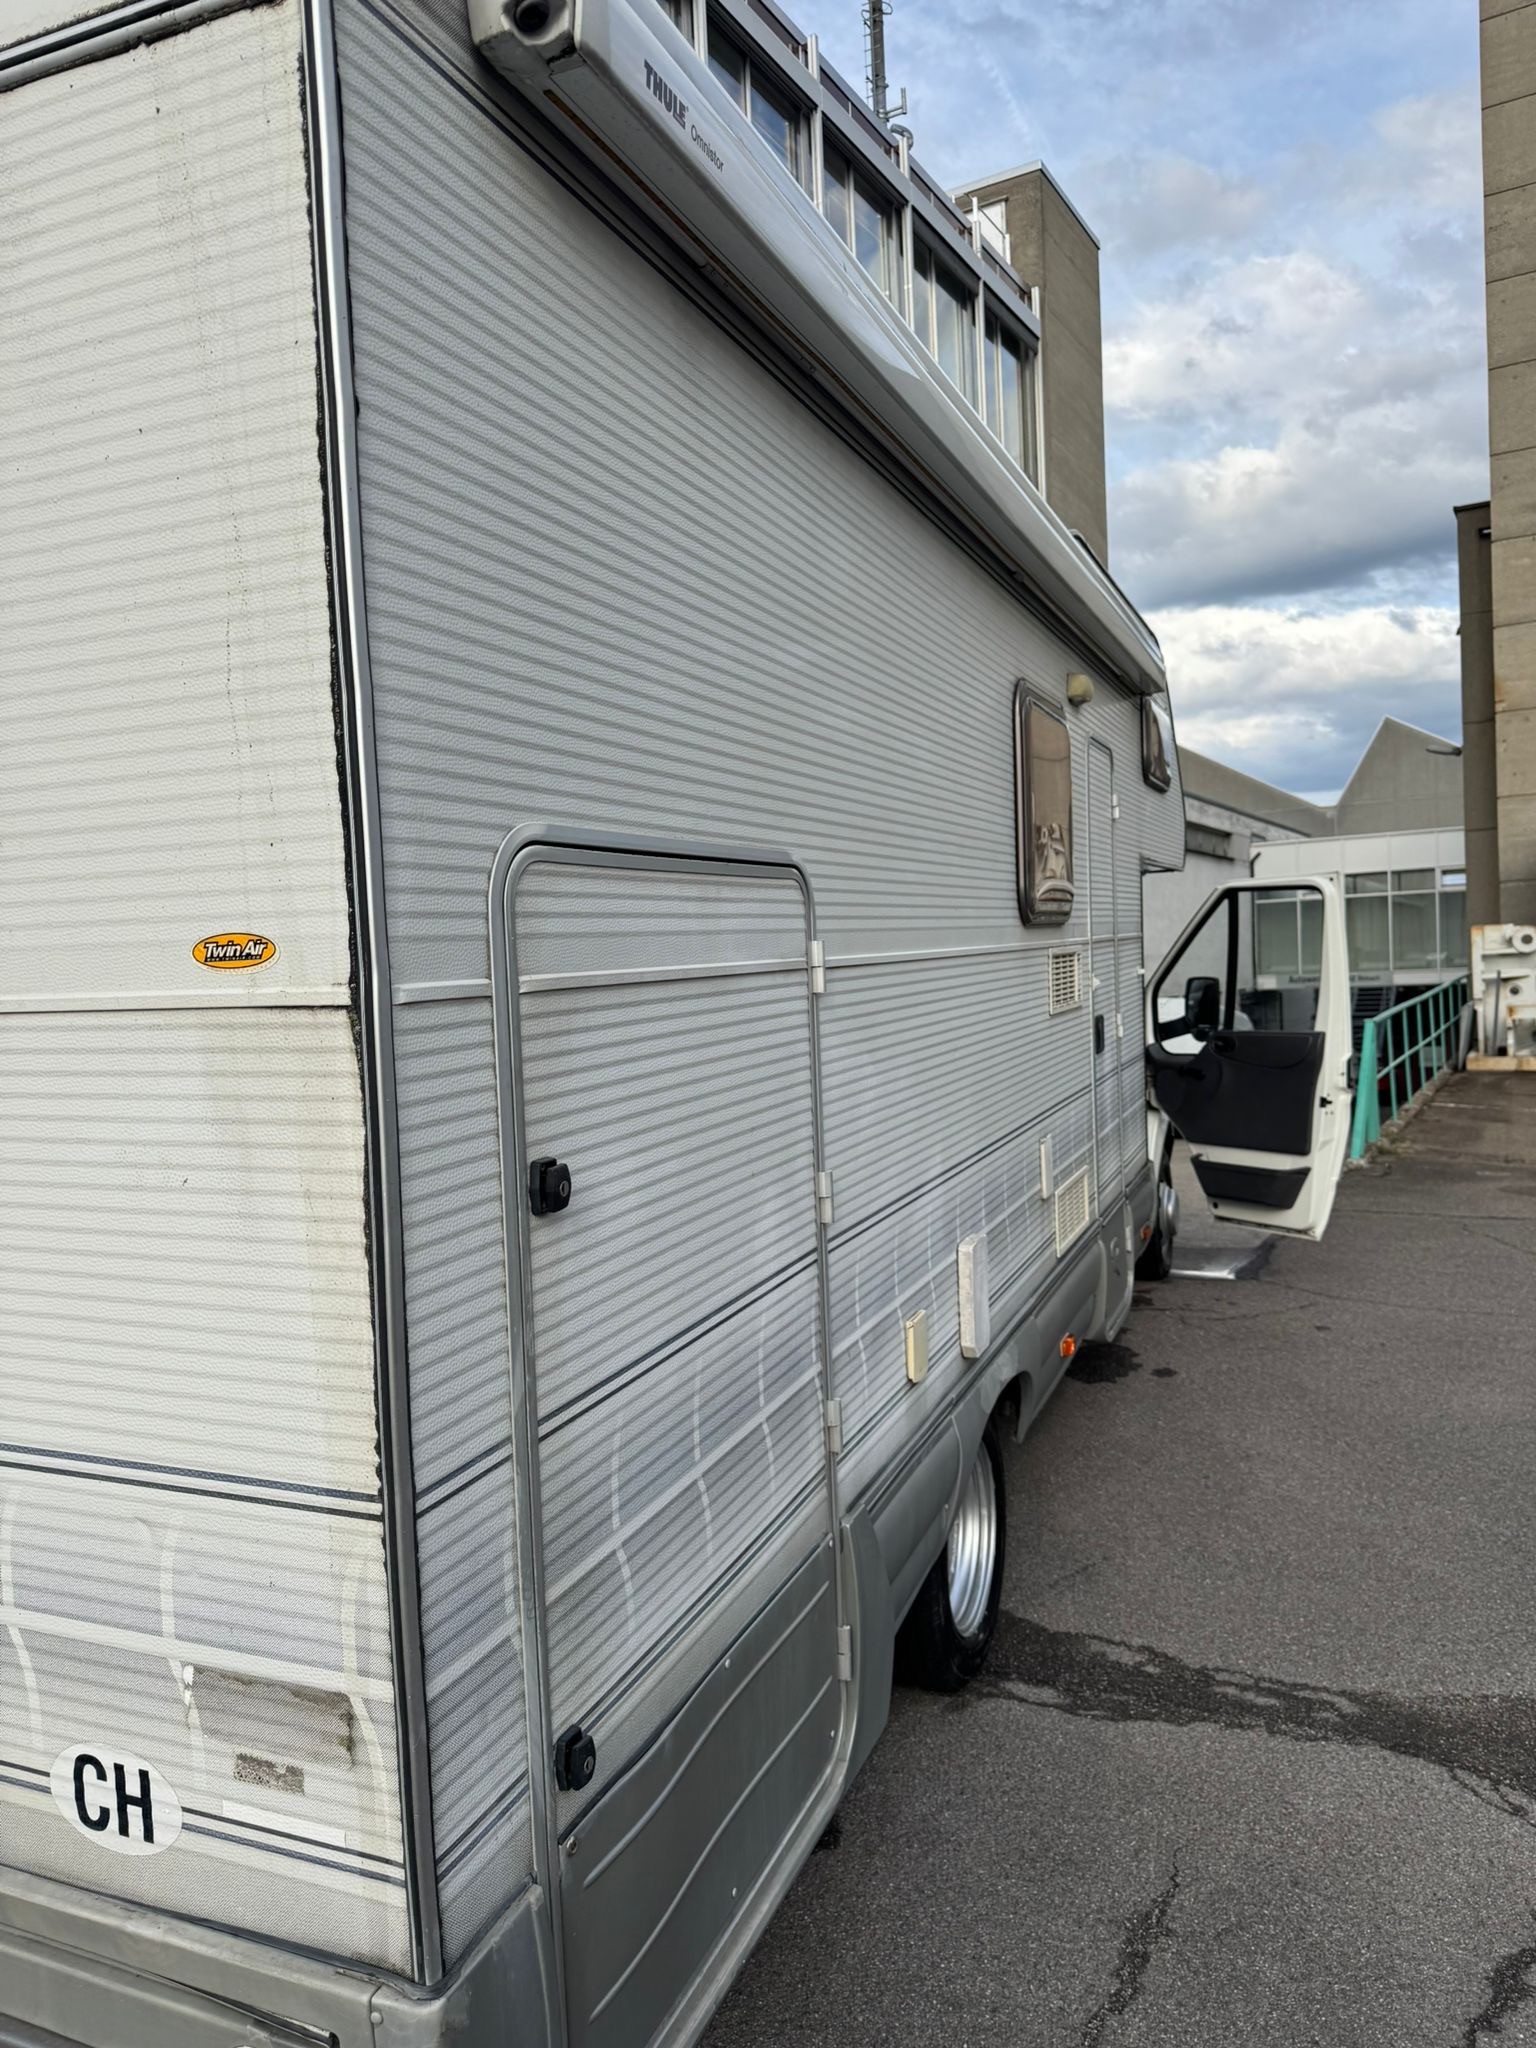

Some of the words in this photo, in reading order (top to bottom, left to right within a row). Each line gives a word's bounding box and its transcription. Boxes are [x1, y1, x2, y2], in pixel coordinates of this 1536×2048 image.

[644, 59, 686, 130] THULE
[690, 124, 724, 173] Omnistor
[205, 941, 242, 958] Twin
[242, 940, 267, 956] Air
[73, 1753, 154, 1844] CH
